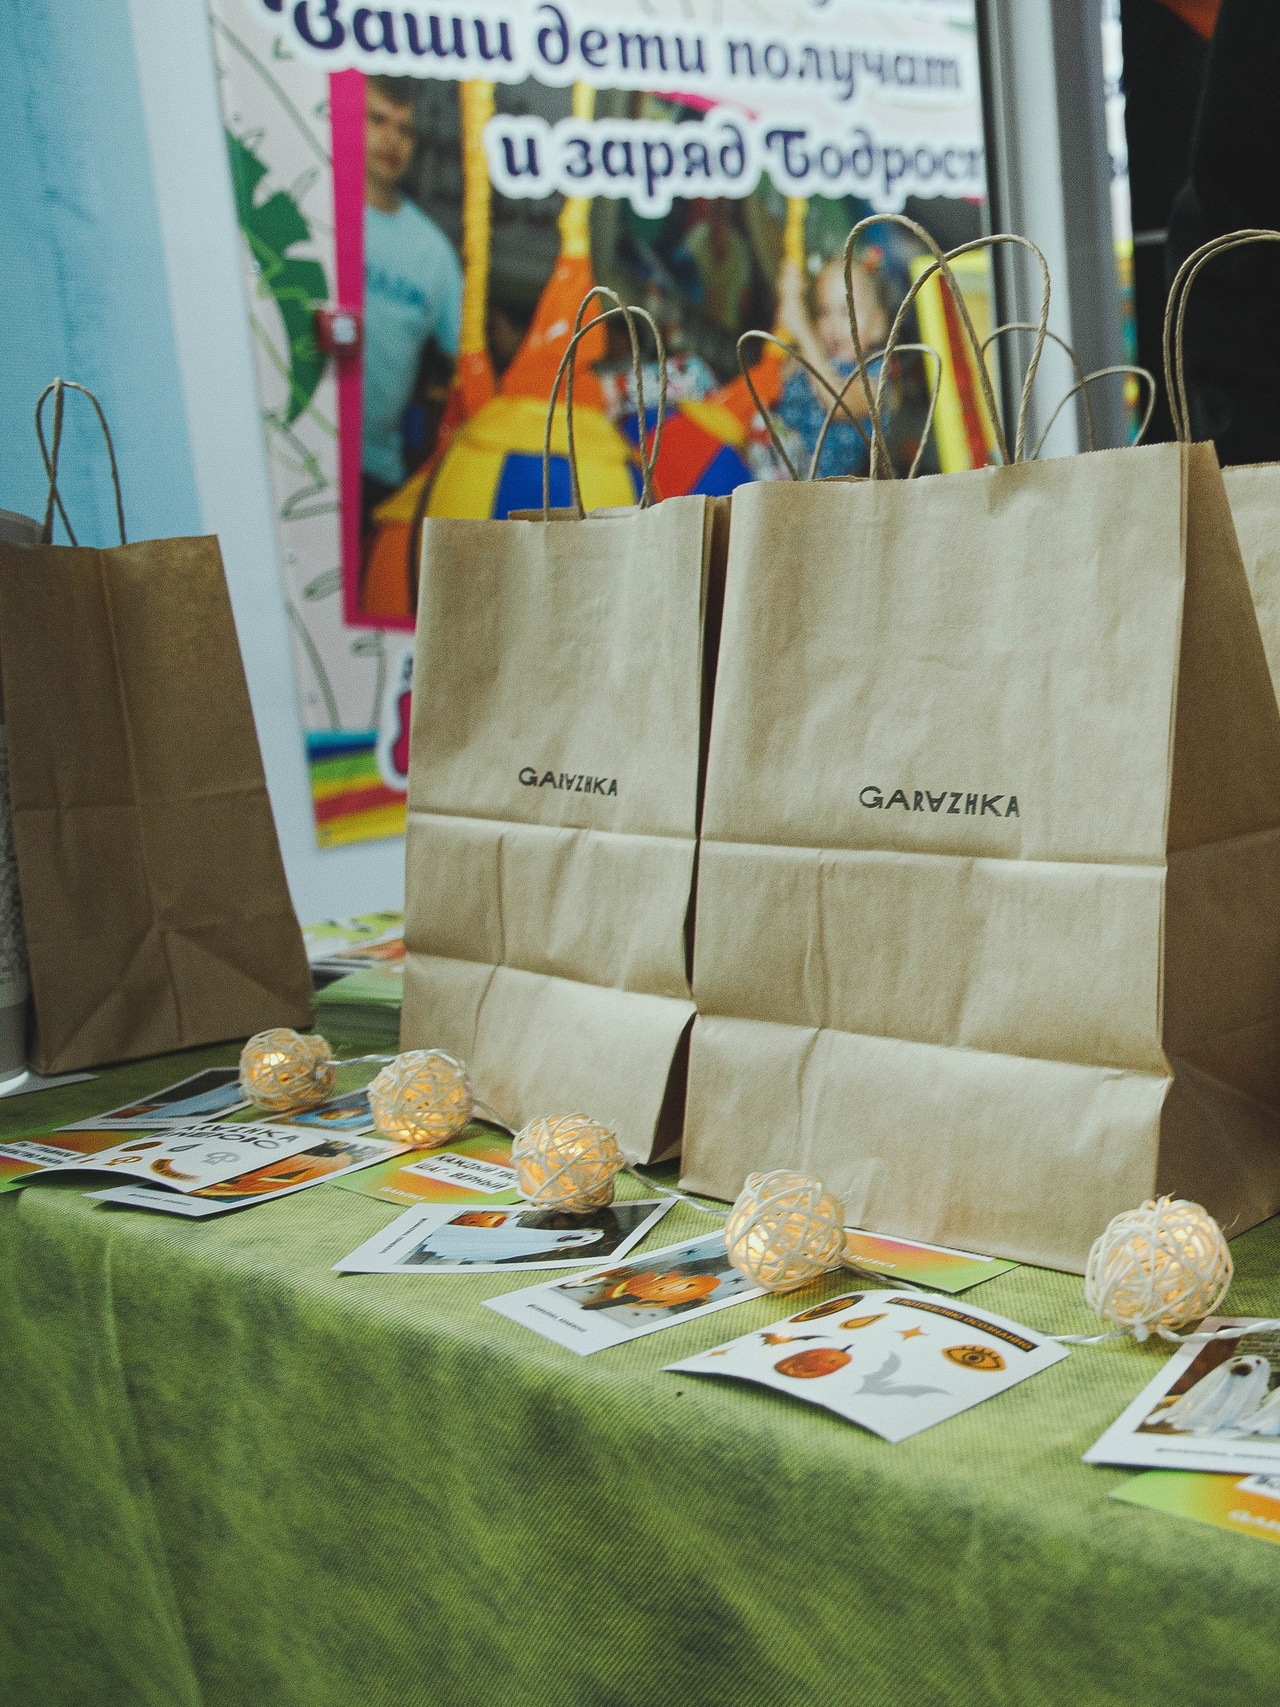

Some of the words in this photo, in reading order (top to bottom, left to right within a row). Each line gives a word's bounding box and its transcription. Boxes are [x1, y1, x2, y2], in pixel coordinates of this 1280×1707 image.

[293, 0, 513, 62] Ваши
[537, 4, 707, 74] дети
[727, 40, 961, 101] получат
[502, 136, 540, 177] и
[565, 124, 745, 198] заряд
